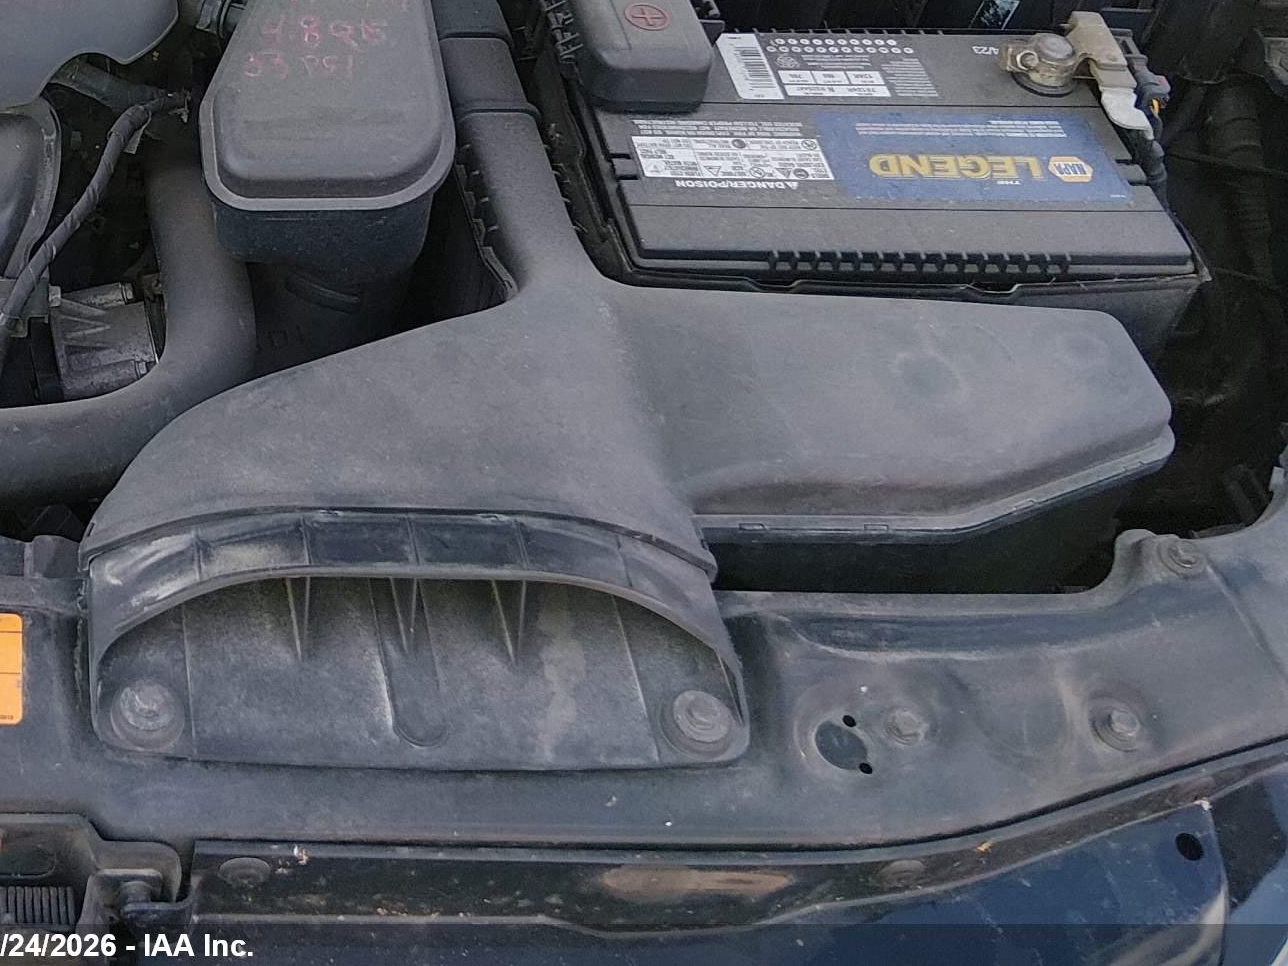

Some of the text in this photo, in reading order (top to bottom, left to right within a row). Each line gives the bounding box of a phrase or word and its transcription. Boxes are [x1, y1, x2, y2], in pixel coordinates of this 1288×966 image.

[868, 153, 1043, 179] LEGEND
[1053, 163, 1087, 176] NAPA
[675, 179, 788, 190] DANGER/POISON
